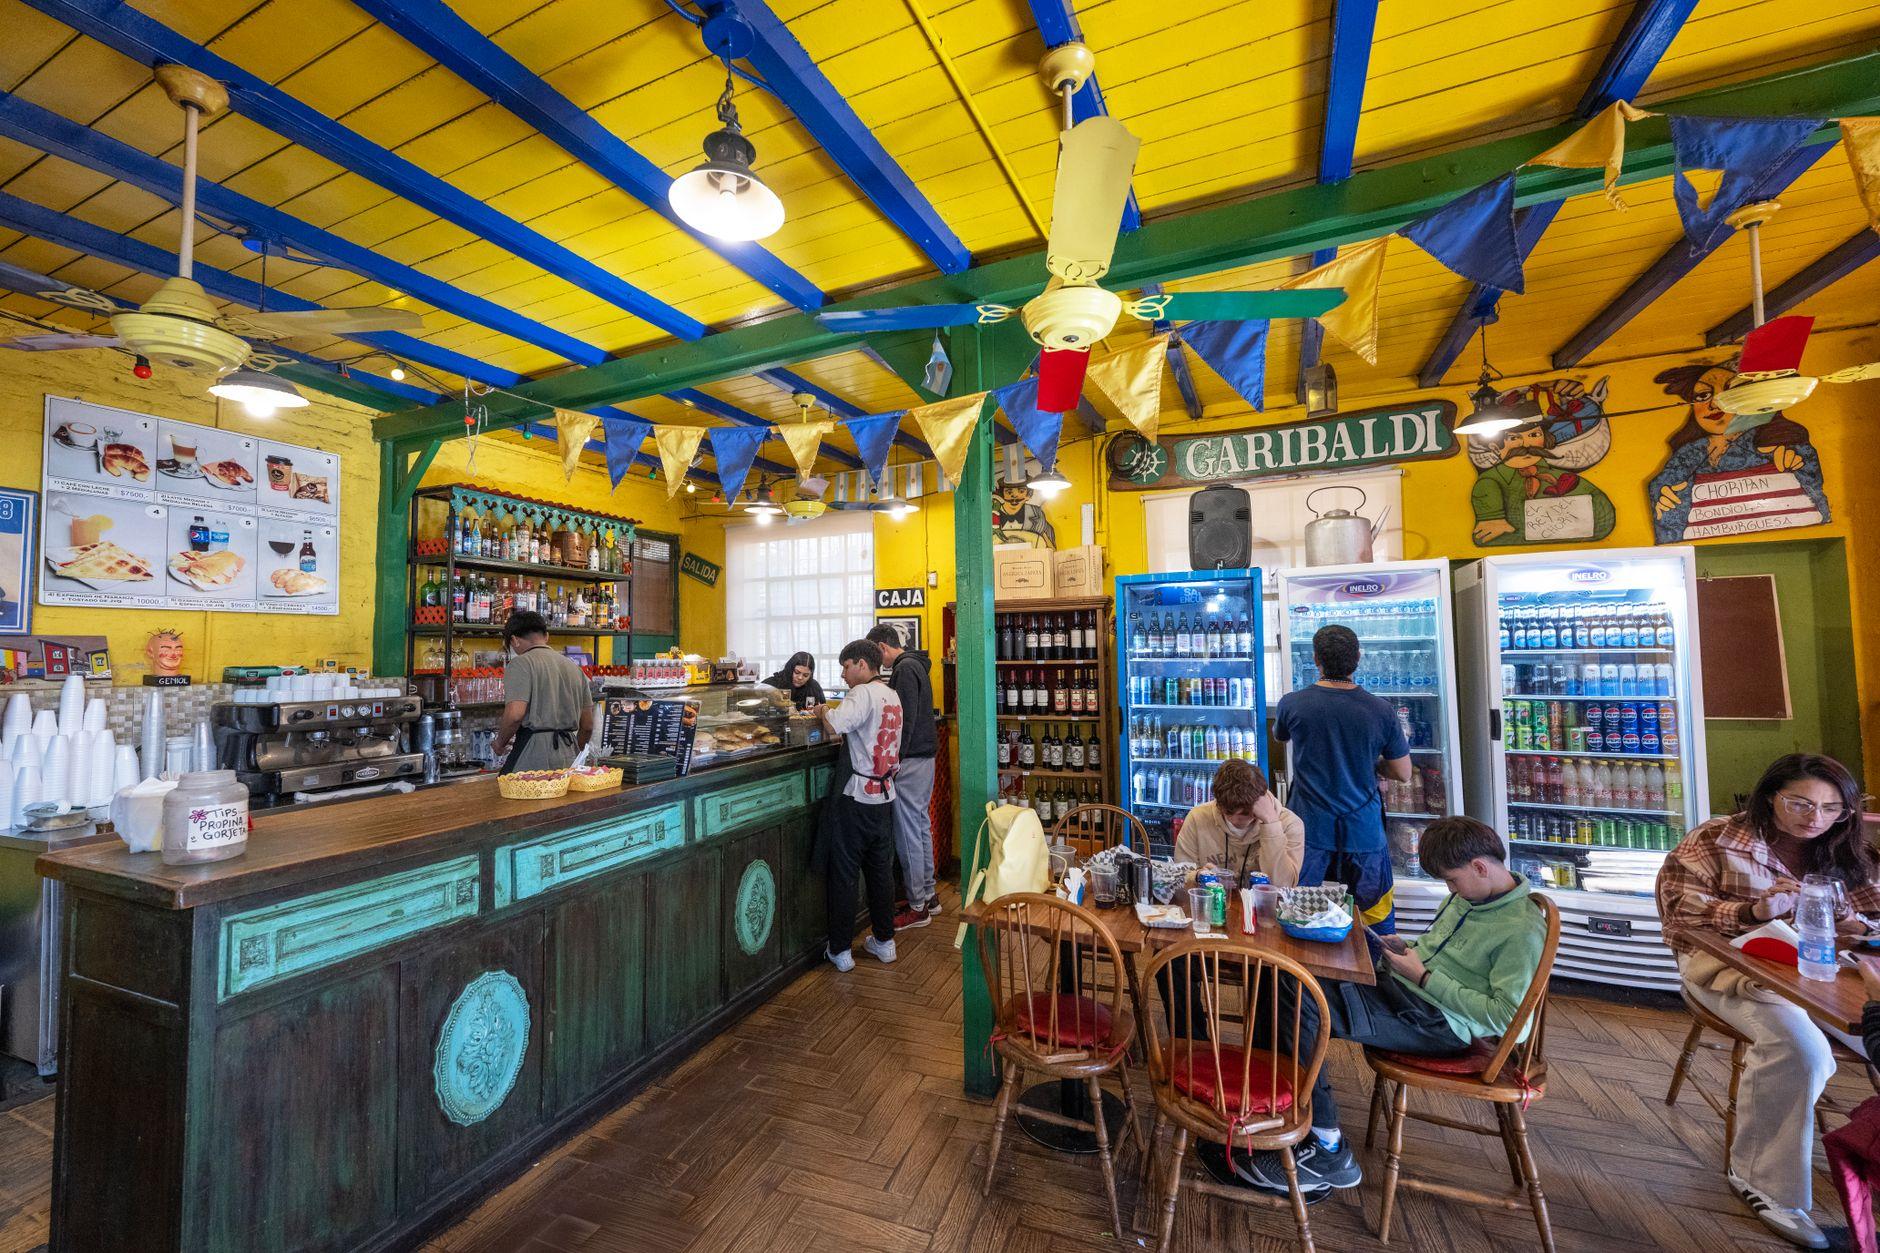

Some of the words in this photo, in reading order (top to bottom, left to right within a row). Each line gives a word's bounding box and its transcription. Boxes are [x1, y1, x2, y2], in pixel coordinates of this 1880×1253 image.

[1186, 410, 1442, 477] GARIBALDI
[1527, 512, 1552, 530] REY
[1551, 497, 1576, 514] DEL
[1692, 517, 1792, 537] HAMBURGUESA
[683, 557, 716, 582] SALIDA
[1572, 572, 1606, 580] INELRO
[1349, 584, 1378, 593] INELRO
[878, 589, 924, 607] CAJA
[158, 676, 189, 685] GENIOL
[208, 808, 238, 818] TIPS
[199, 816, 243, 831] PROPINA
[202, 827, 246, 840] GORJETA
